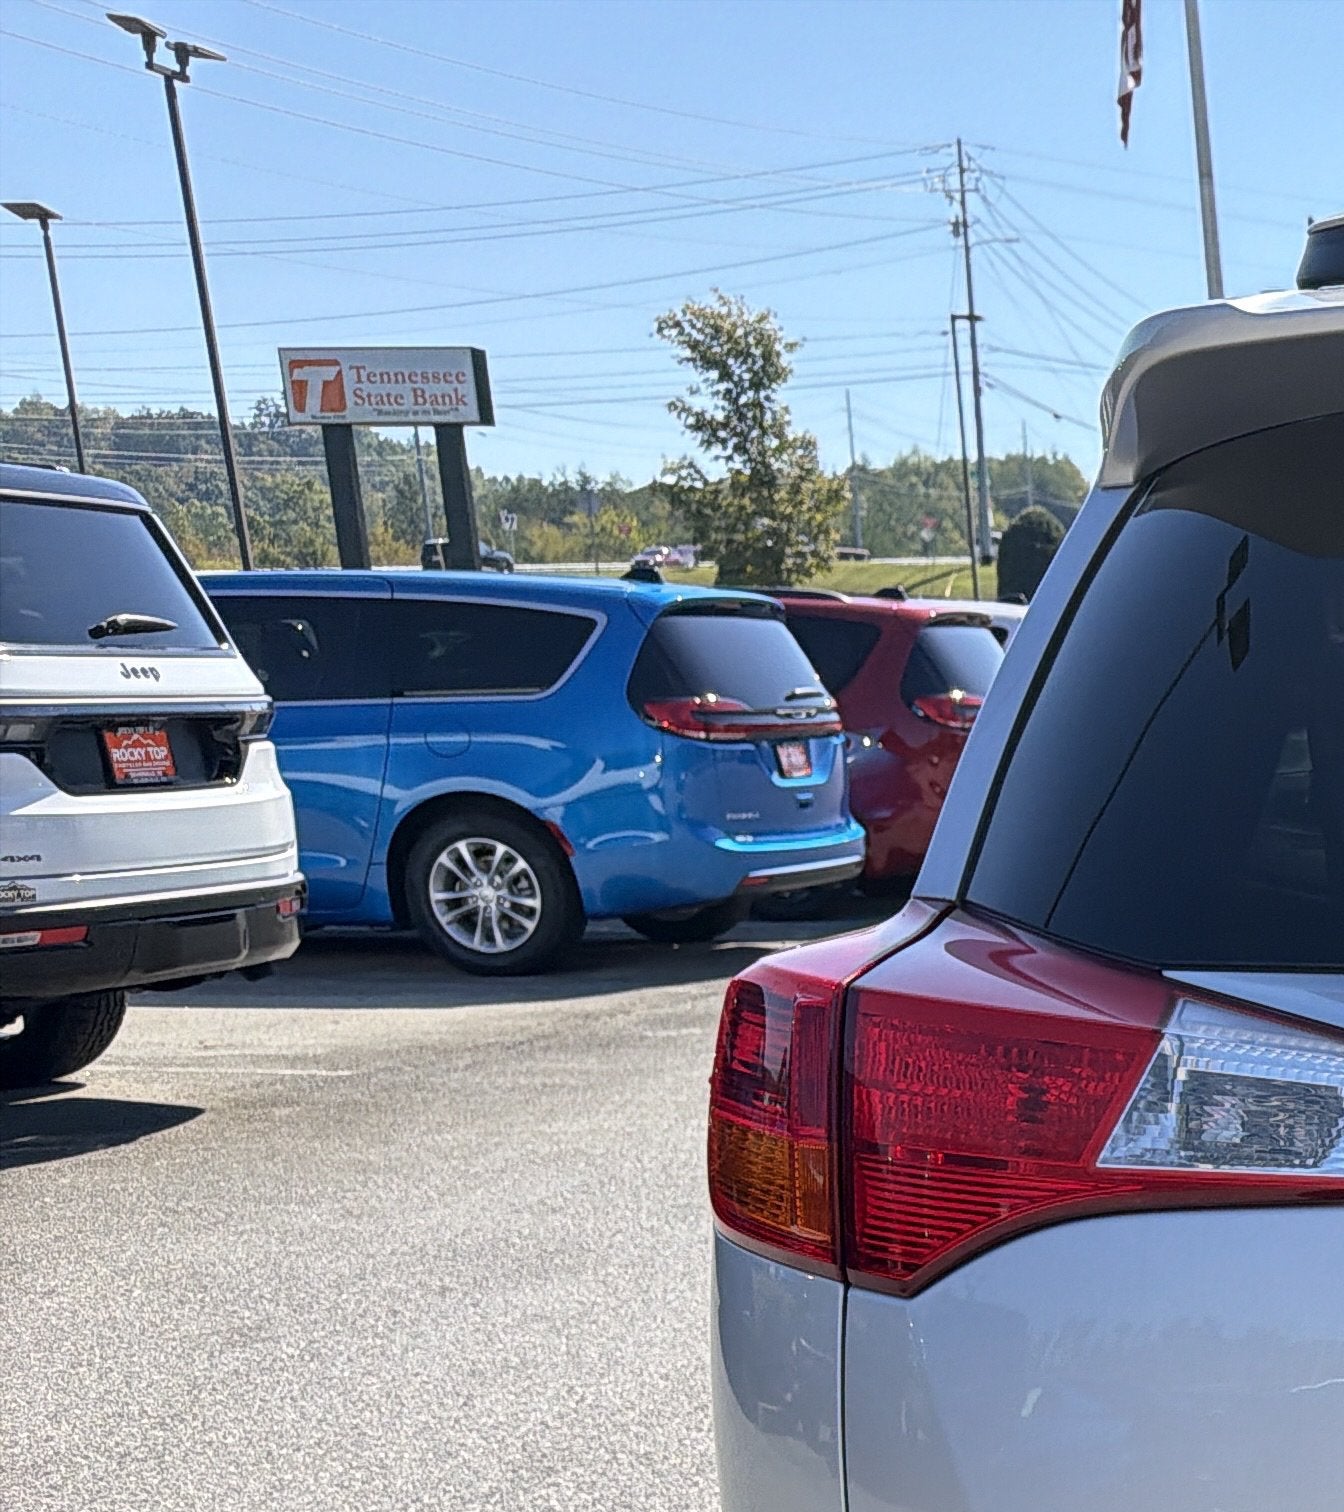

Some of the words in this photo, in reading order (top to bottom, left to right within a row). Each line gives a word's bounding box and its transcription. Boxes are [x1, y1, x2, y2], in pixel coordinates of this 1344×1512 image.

[349, 365, 467, 385] Tennessee
[352, 387, 405, 407] State
[411, 387, 468, 407] Bank
[120, 662, 160, 682] Jeep
[110, 747, 145, 762] ROCKY
[146, 746, 168, 761] TOP
